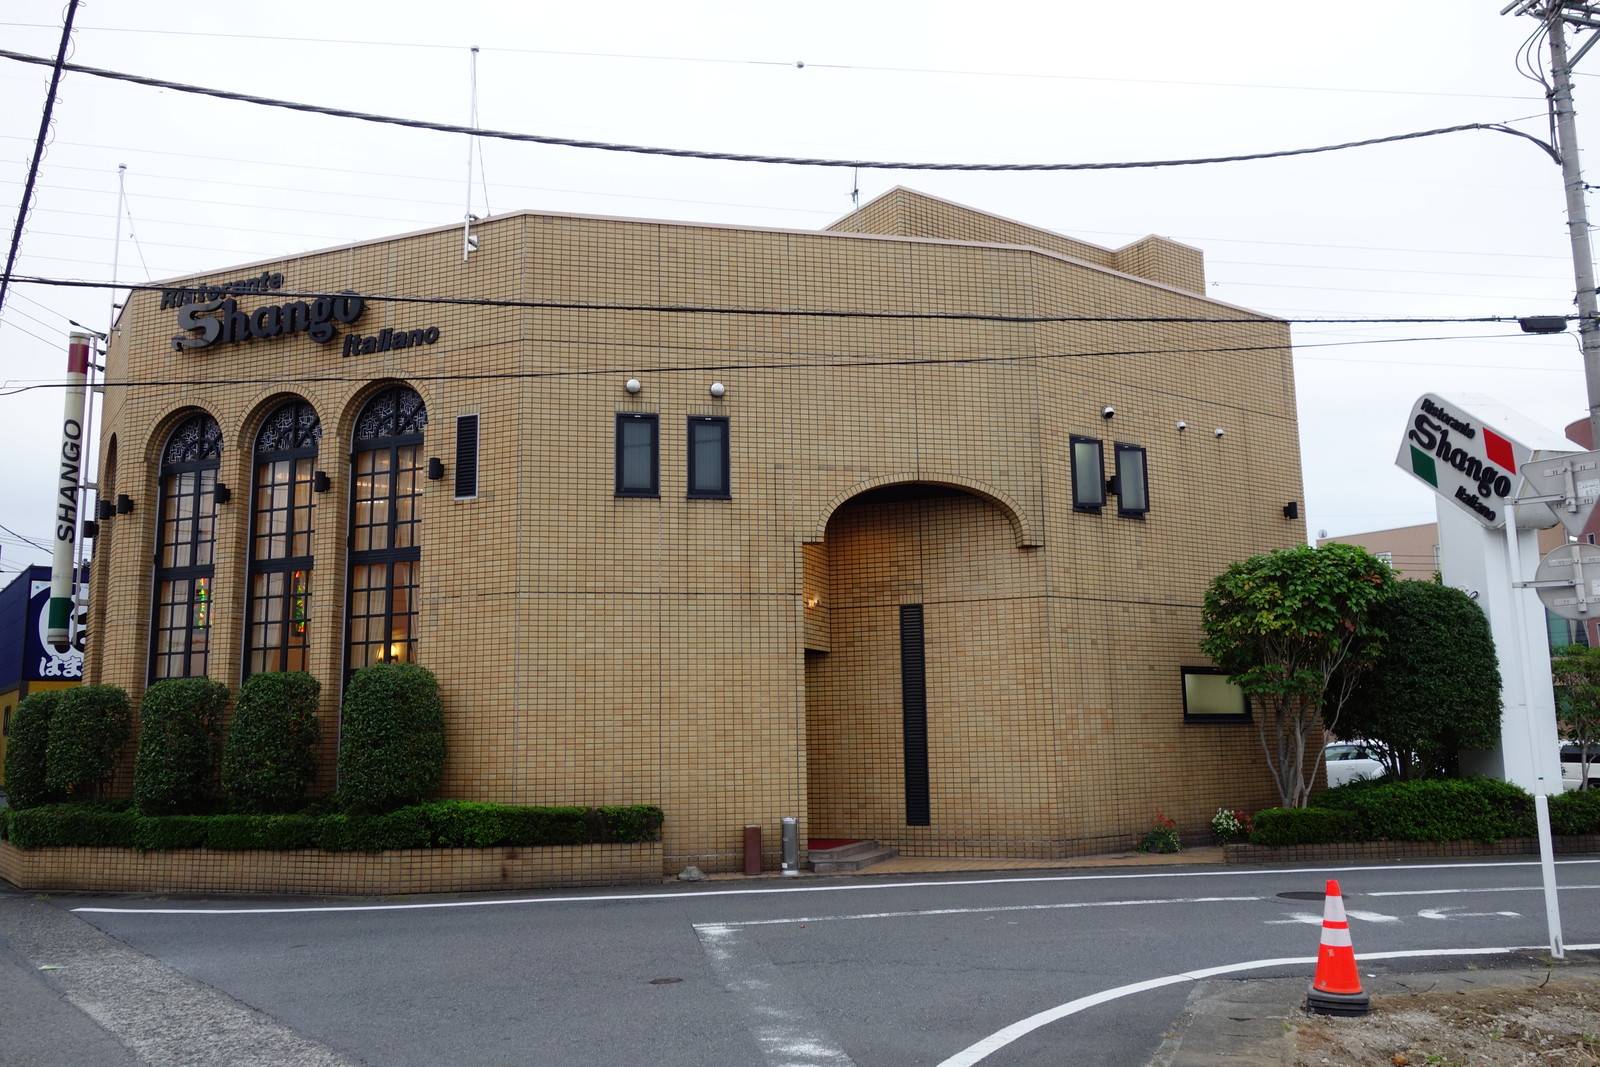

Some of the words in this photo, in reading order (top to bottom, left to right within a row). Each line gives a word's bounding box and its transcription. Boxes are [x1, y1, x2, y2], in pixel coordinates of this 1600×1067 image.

[171, 290, 364, 351] Shango
[342, 325, 440, 357] Italiano
[57, 418, 81, 543] SHANGO
[1408, 413, 1511, 498] Shango
[39, 655, 83, 678] はま
